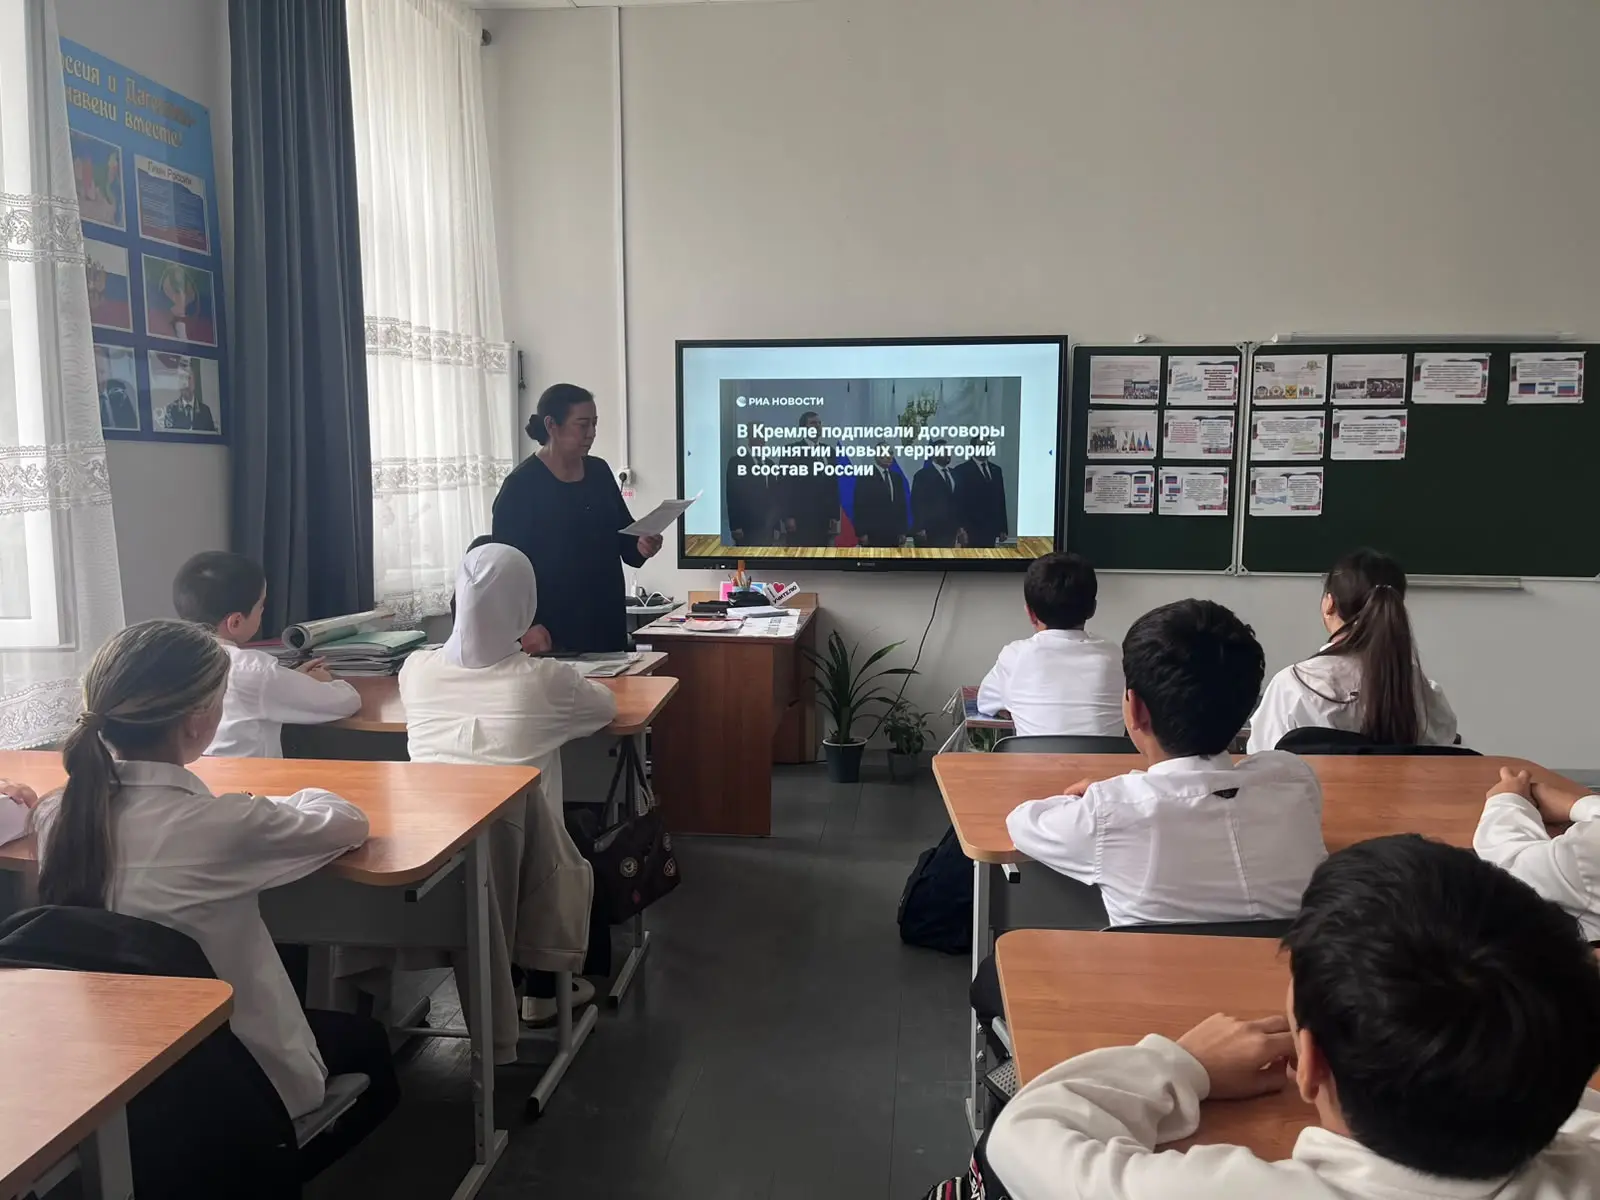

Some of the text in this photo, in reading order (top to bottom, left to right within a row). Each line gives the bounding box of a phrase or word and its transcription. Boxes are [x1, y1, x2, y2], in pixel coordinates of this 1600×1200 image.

[63, 55, 100, 86] ссия
[108, 75, 116, 93] и
[748, 396, 825, 407] РИА НОВОСТИ
[736, 423, 1006, 443] В Кремле подписали договоры
[736, 441, 997, 462] о принятии новых территорий
[737, 461, 874, 477] в состав России
